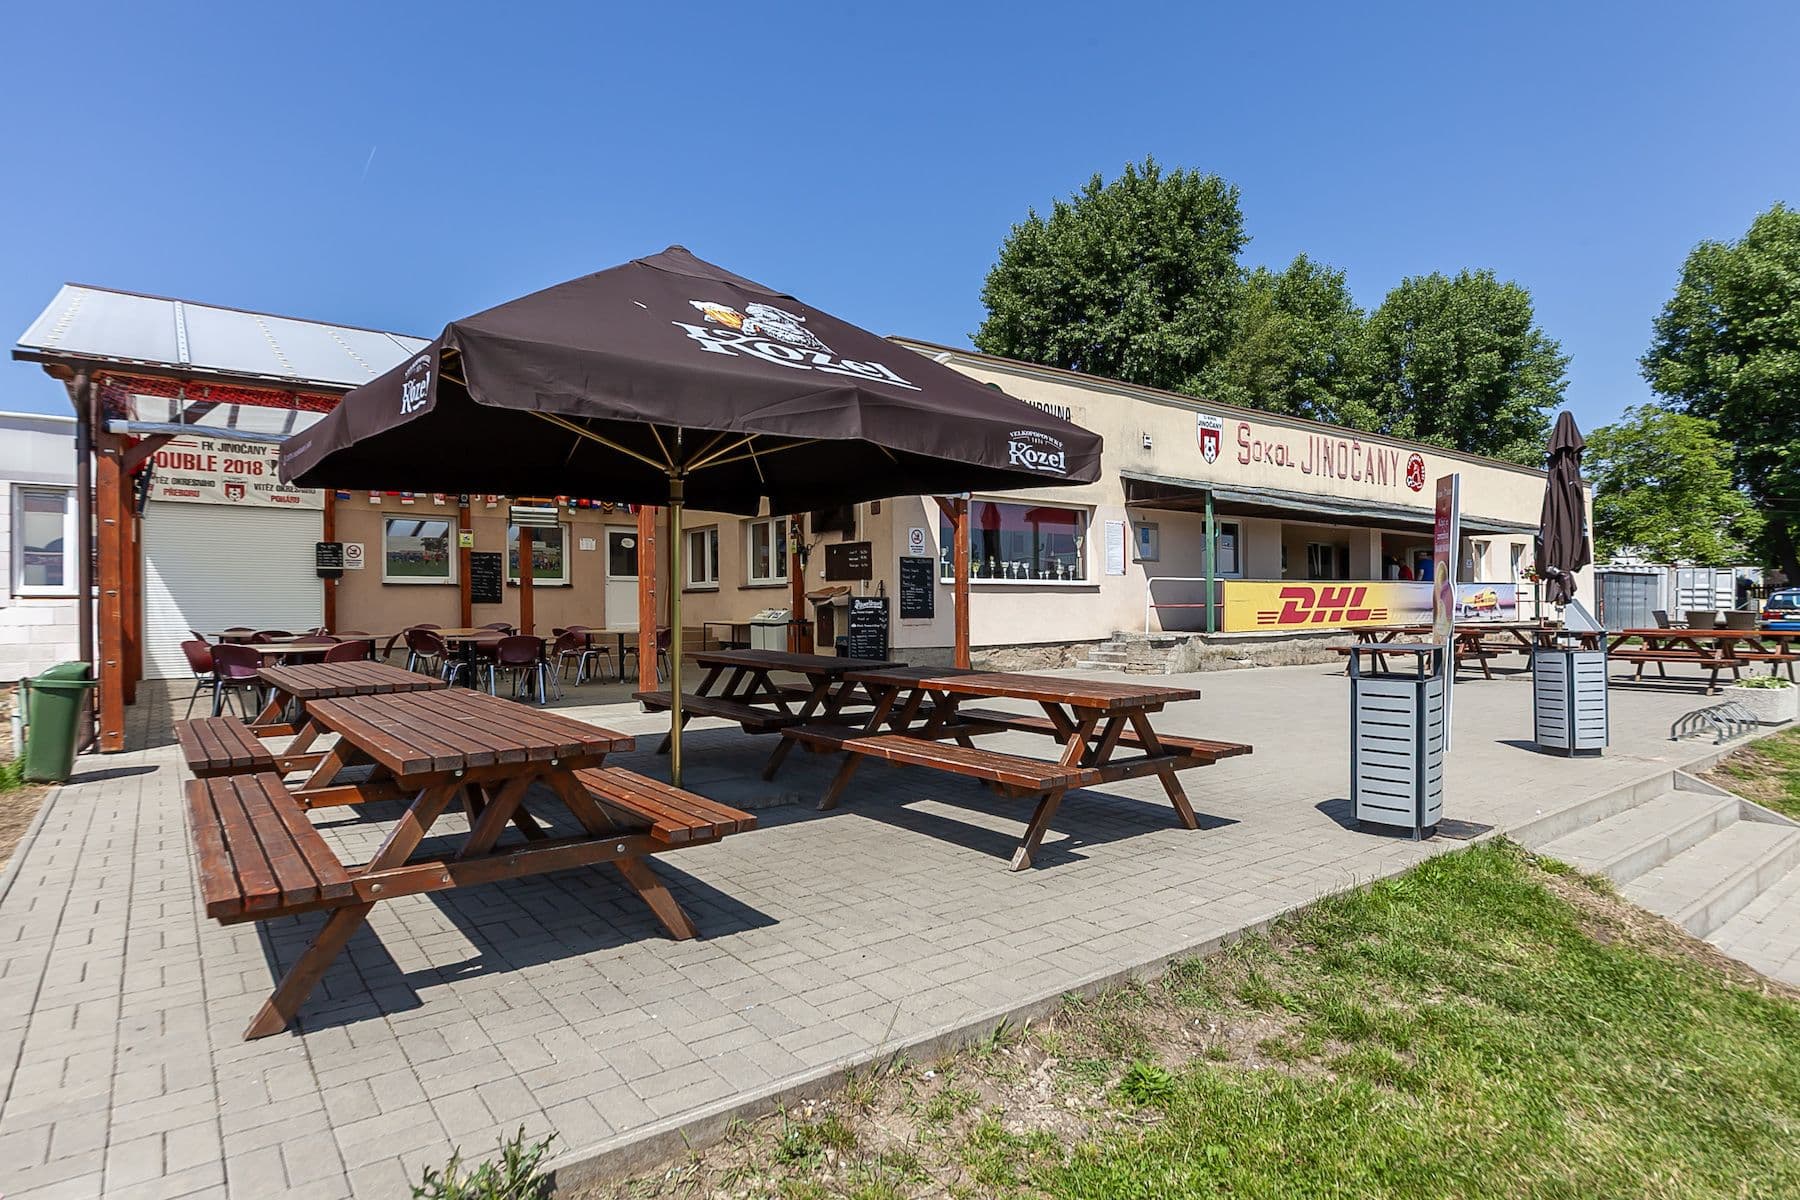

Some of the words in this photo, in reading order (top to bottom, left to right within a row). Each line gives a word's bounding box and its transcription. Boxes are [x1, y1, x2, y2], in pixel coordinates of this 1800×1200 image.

[672, 321, 922, 391] Kozel
[400, 371, 430, 415] Kozel
[156, 451, 217, 473] OUBLE
[223, 458, 263, 476] 2018
[201, 441, 214, 451] FK
[217, 442, 268, 456] JINOČANY
[1007, 440, 1067, 474] Kozel
[1301, 435, 1400, 487] JINOČANY
[1277, 586, 1372, 625] DHL
